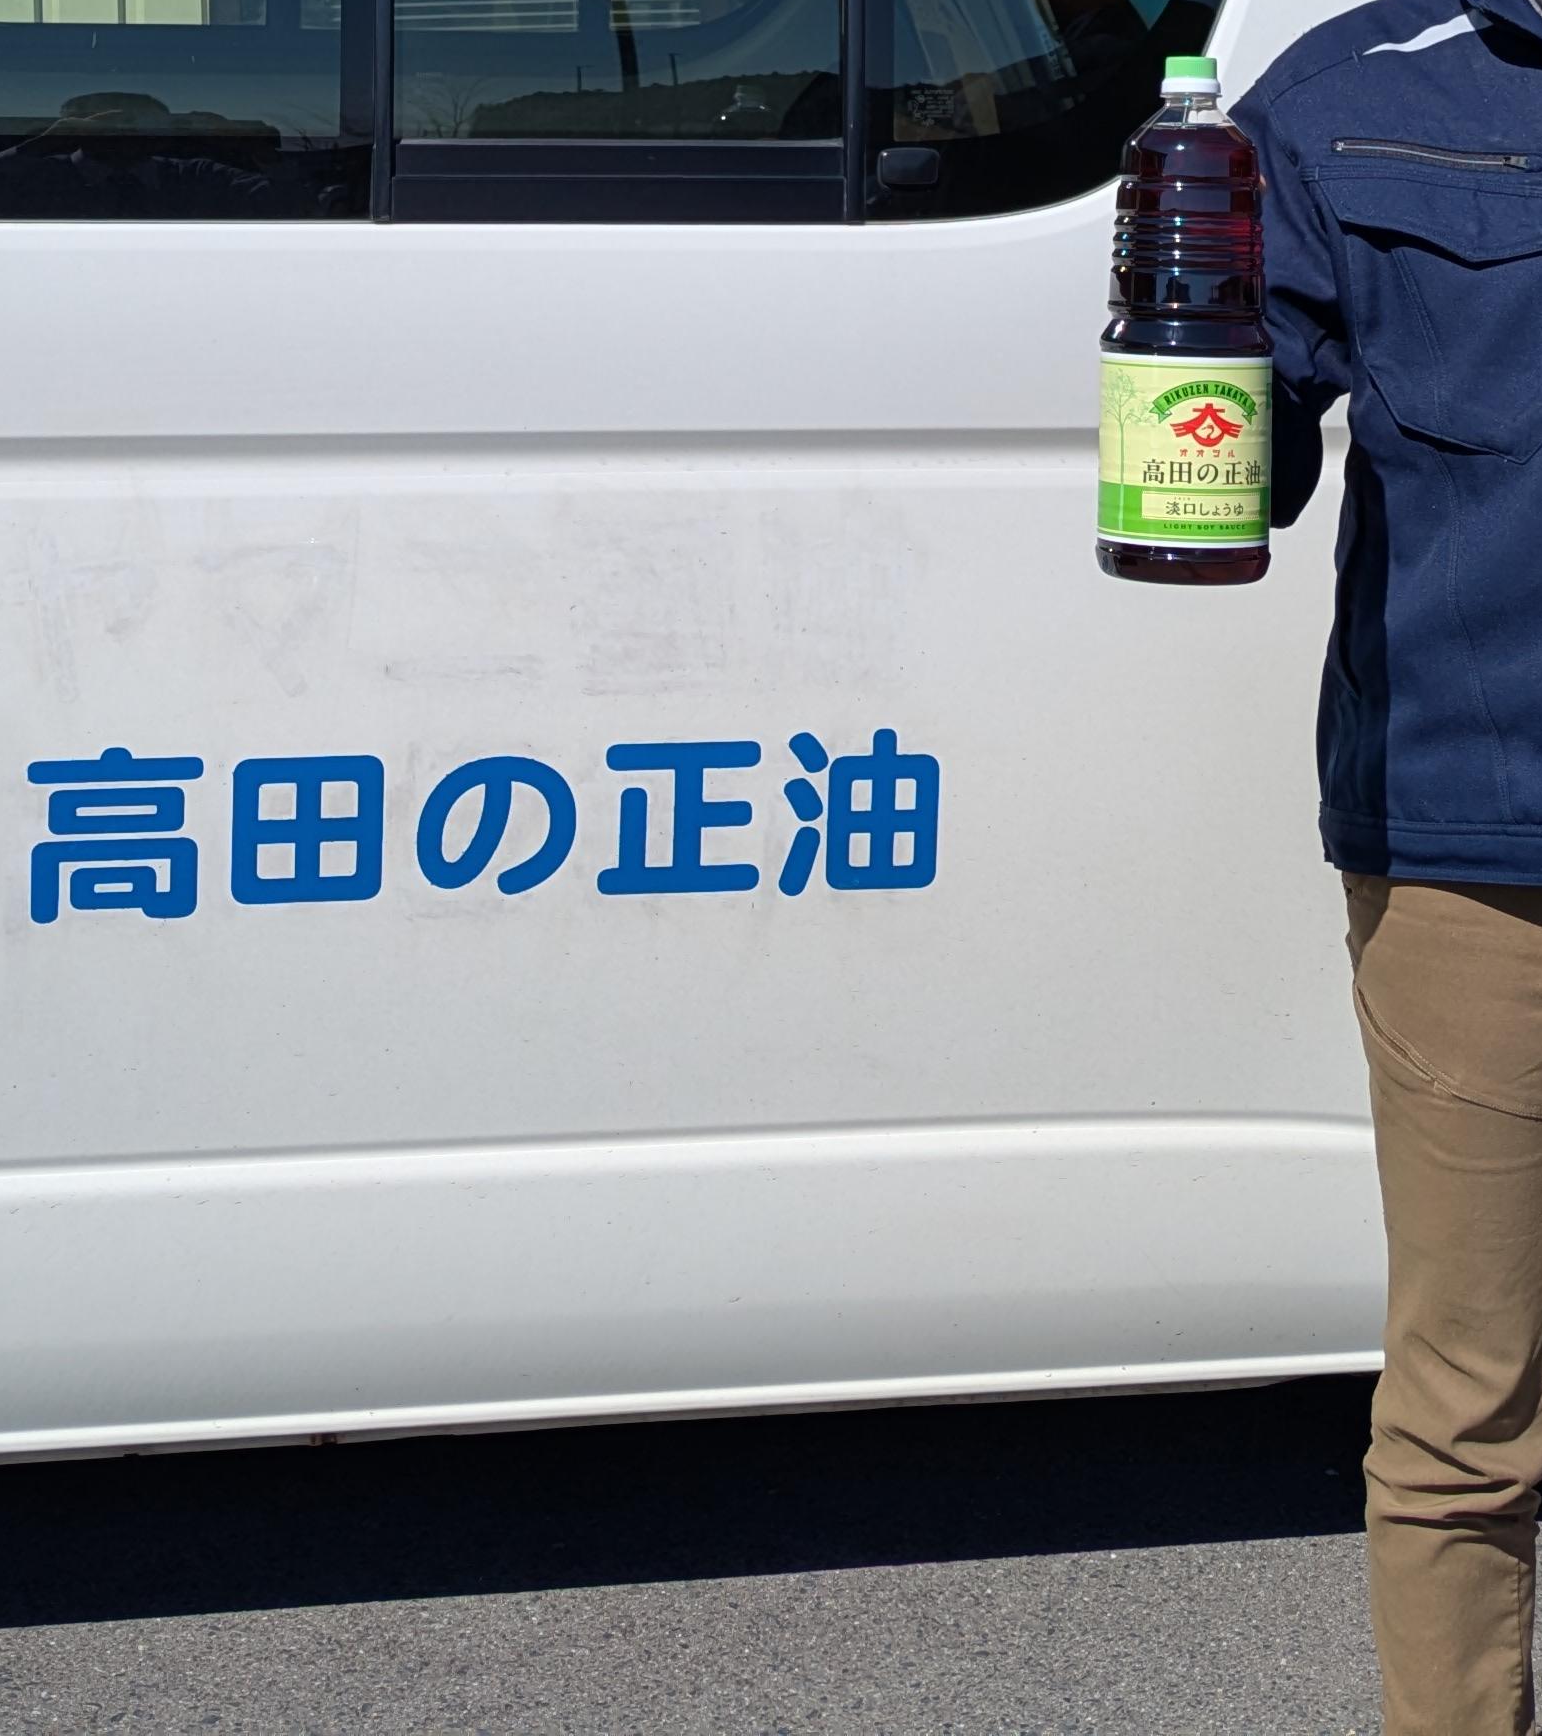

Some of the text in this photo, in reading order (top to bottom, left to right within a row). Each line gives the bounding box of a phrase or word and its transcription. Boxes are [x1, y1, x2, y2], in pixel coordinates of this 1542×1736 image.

[1162, 384, 1249, 407] RIKUZEN TAKATA
[1142, 458, 1261, 486] 高田の正油
[1165, 501, 1244, 517] 淡口しょうゆ
[1219, 523, 1247, 531] SAUCE
[27, 728, 940, 924] 高田の正油
